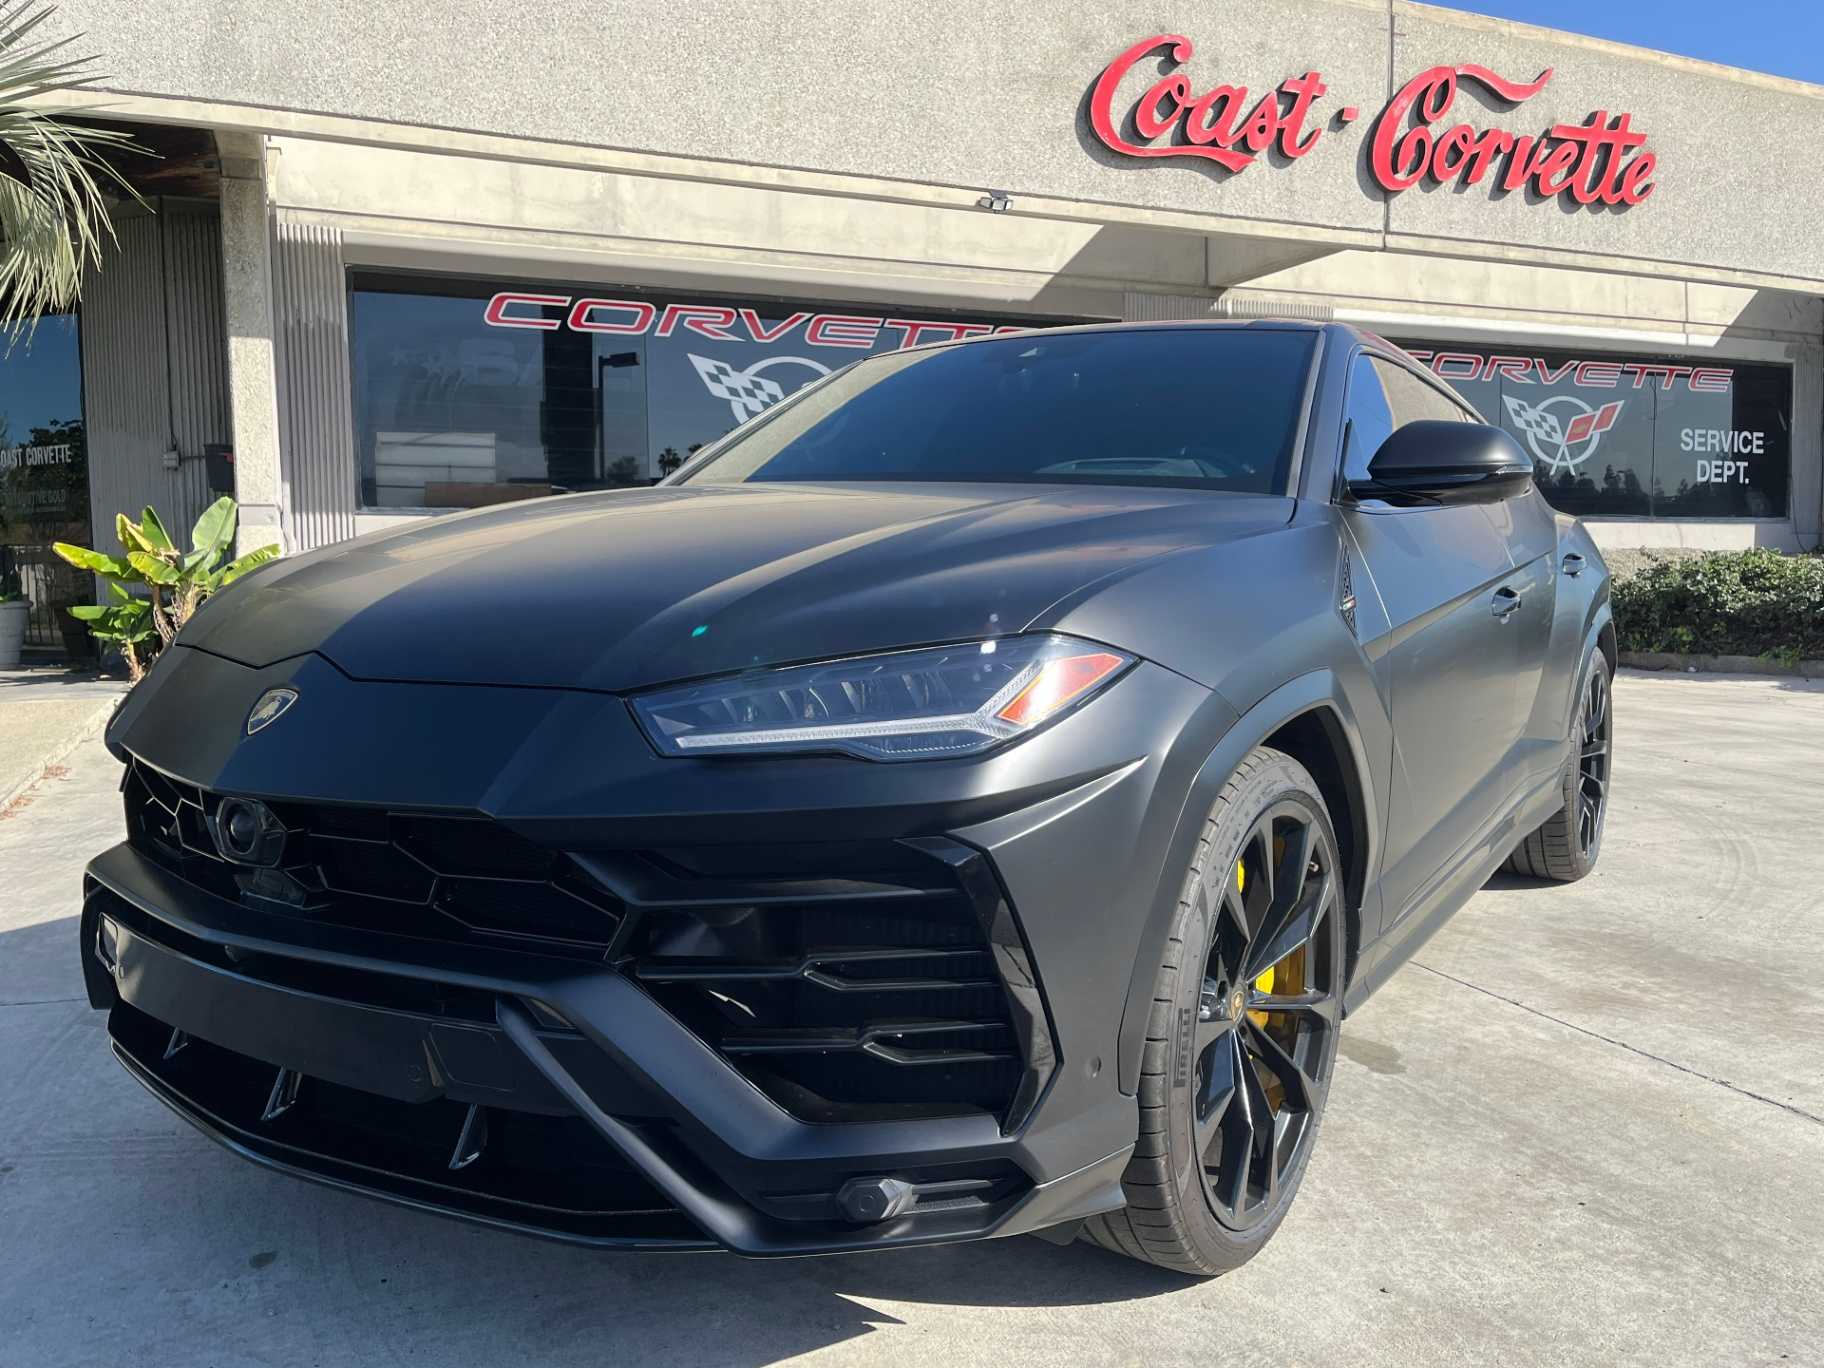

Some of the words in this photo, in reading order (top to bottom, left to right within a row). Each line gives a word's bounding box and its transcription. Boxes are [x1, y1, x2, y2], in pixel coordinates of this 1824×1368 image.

[1090, 34, 1327, 172] Coast
[1373, 65, 1656, 206] Corvette
[483, 292, 1038, 350] CORVETT
[25, 444, 72, 466] CORVETTE
[1680, 428, 1765, 455] SERVICE
[1696, 459, 1750, 484] DEPT.
